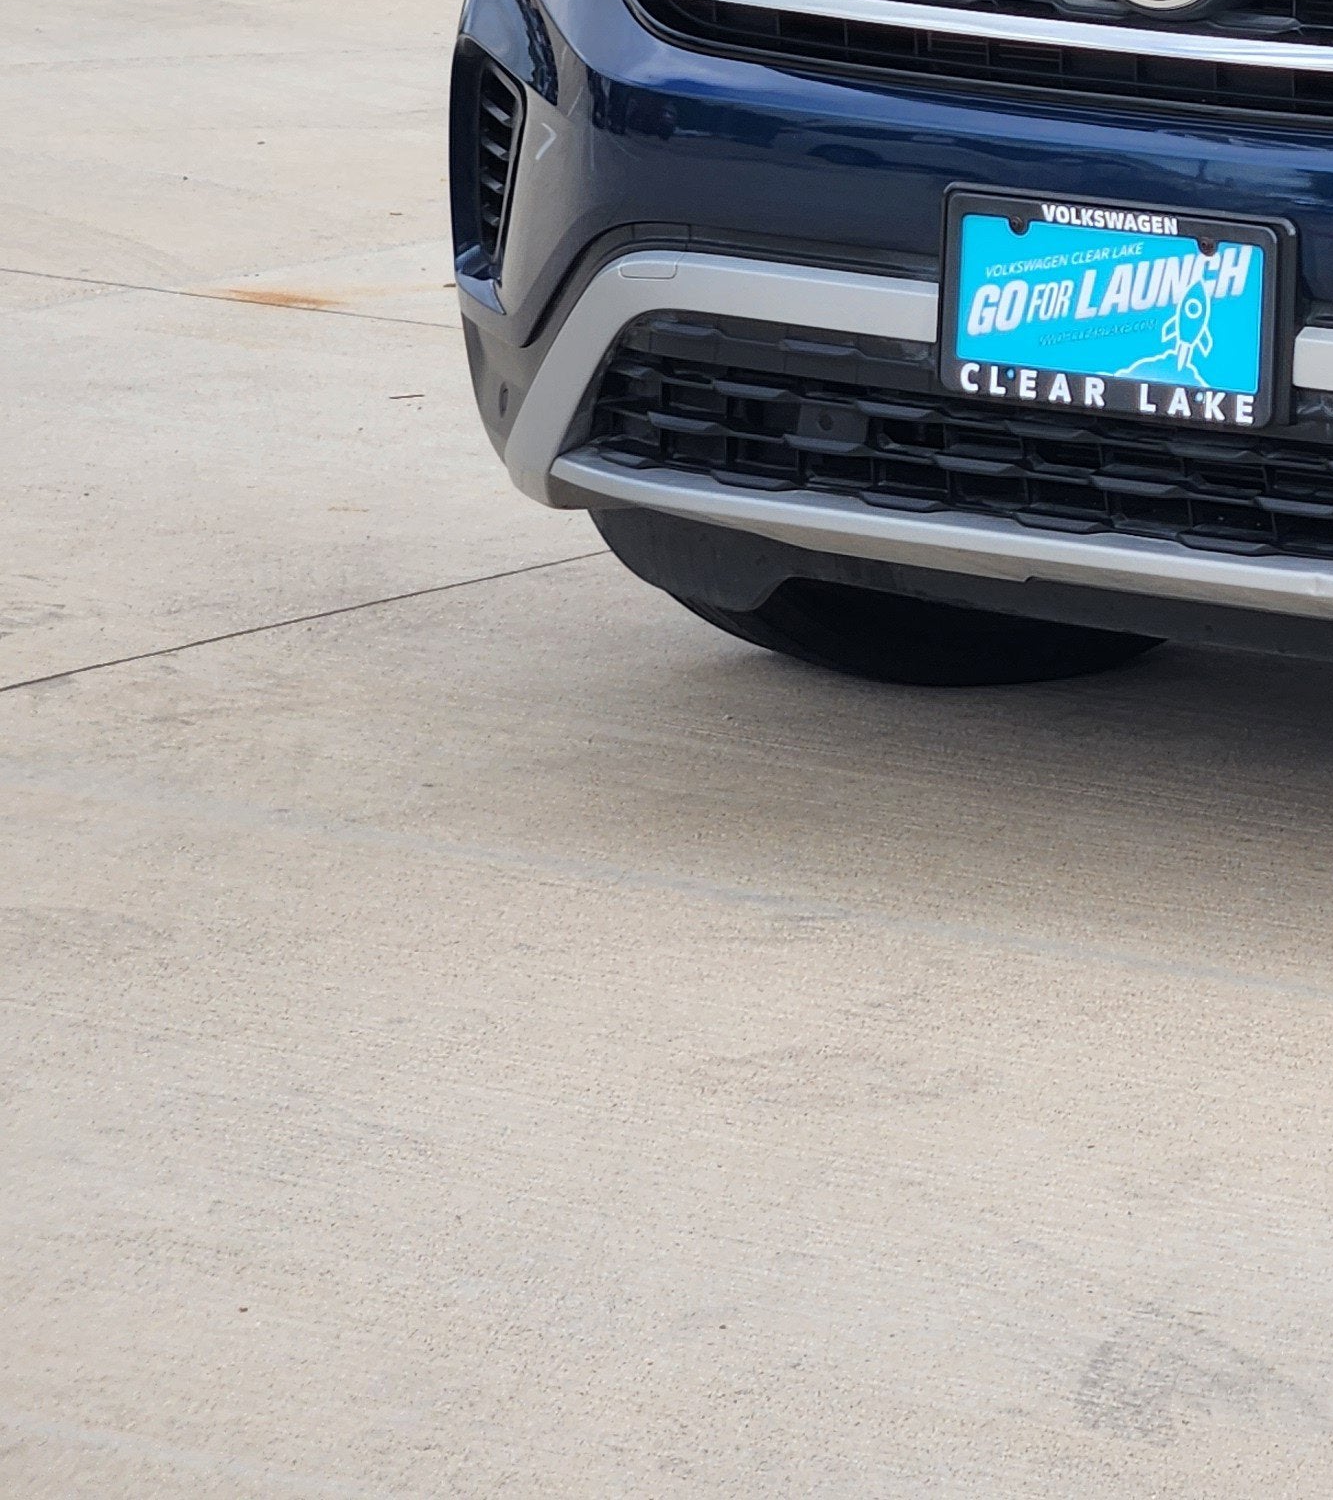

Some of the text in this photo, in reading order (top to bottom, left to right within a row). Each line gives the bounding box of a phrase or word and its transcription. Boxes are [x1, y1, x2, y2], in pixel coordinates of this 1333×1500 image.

[1042, 204, 1179, 236] VOLKSWAGEN
[985, 241, 1145, 278] VOLKSWAGEN CLEAR LAKE
[967, 244, 1252, 337] GO FOR LAUNCH
[960, 361, 1255, 425] CLEAR LAKE
